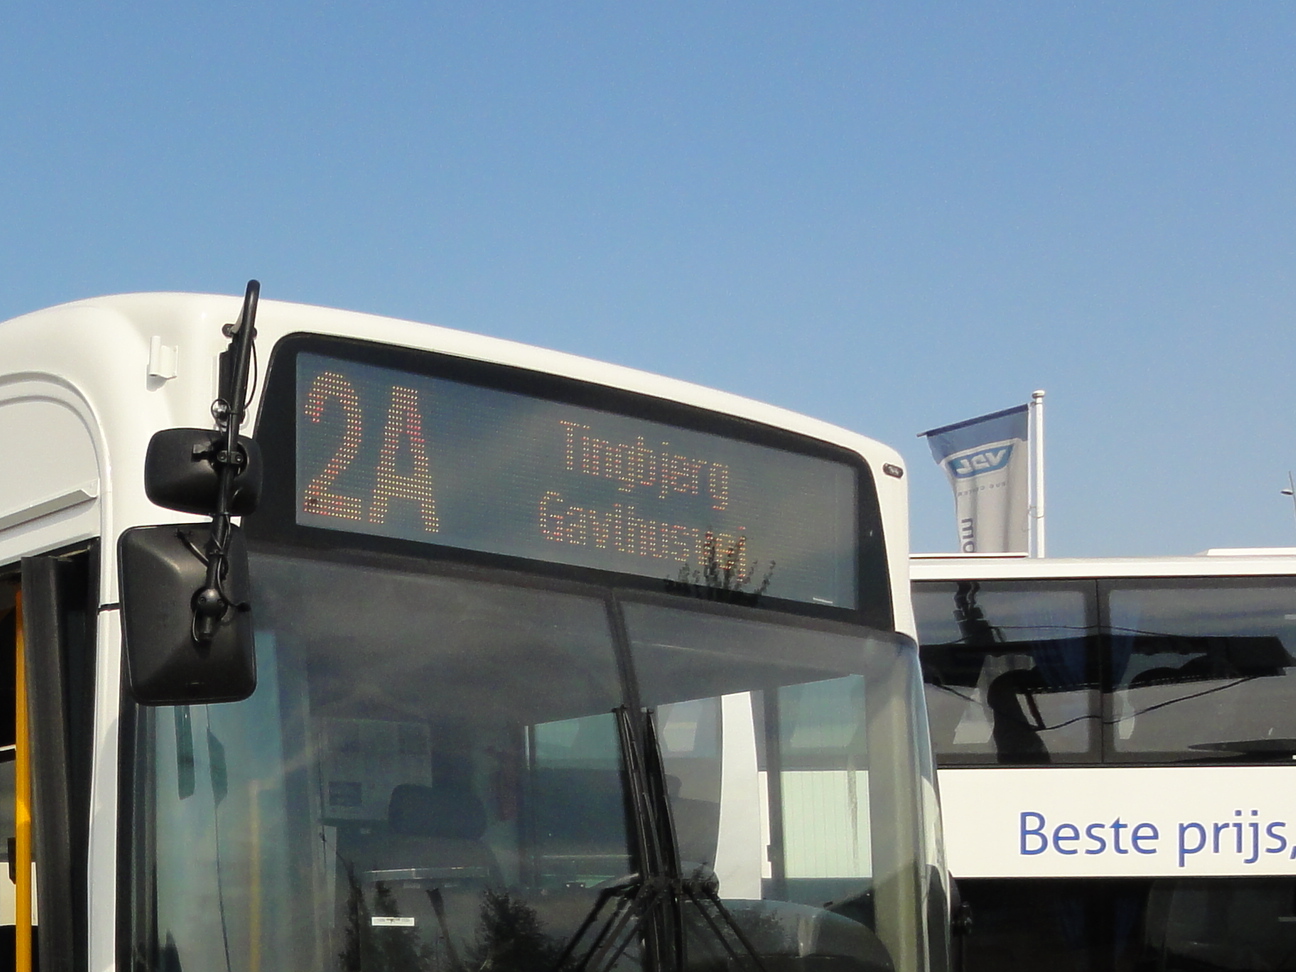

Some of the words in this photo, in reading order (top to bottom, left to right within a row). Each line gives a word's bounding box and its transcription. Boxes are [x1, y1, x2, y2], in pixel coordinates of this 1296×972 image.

[304, 371, 439, 533] 2A
[559, 420, 729, 511] Tingbjerg
[1019, 811, 1159, 855] Beste
[1177, 809, 1296, 868] prijs,
